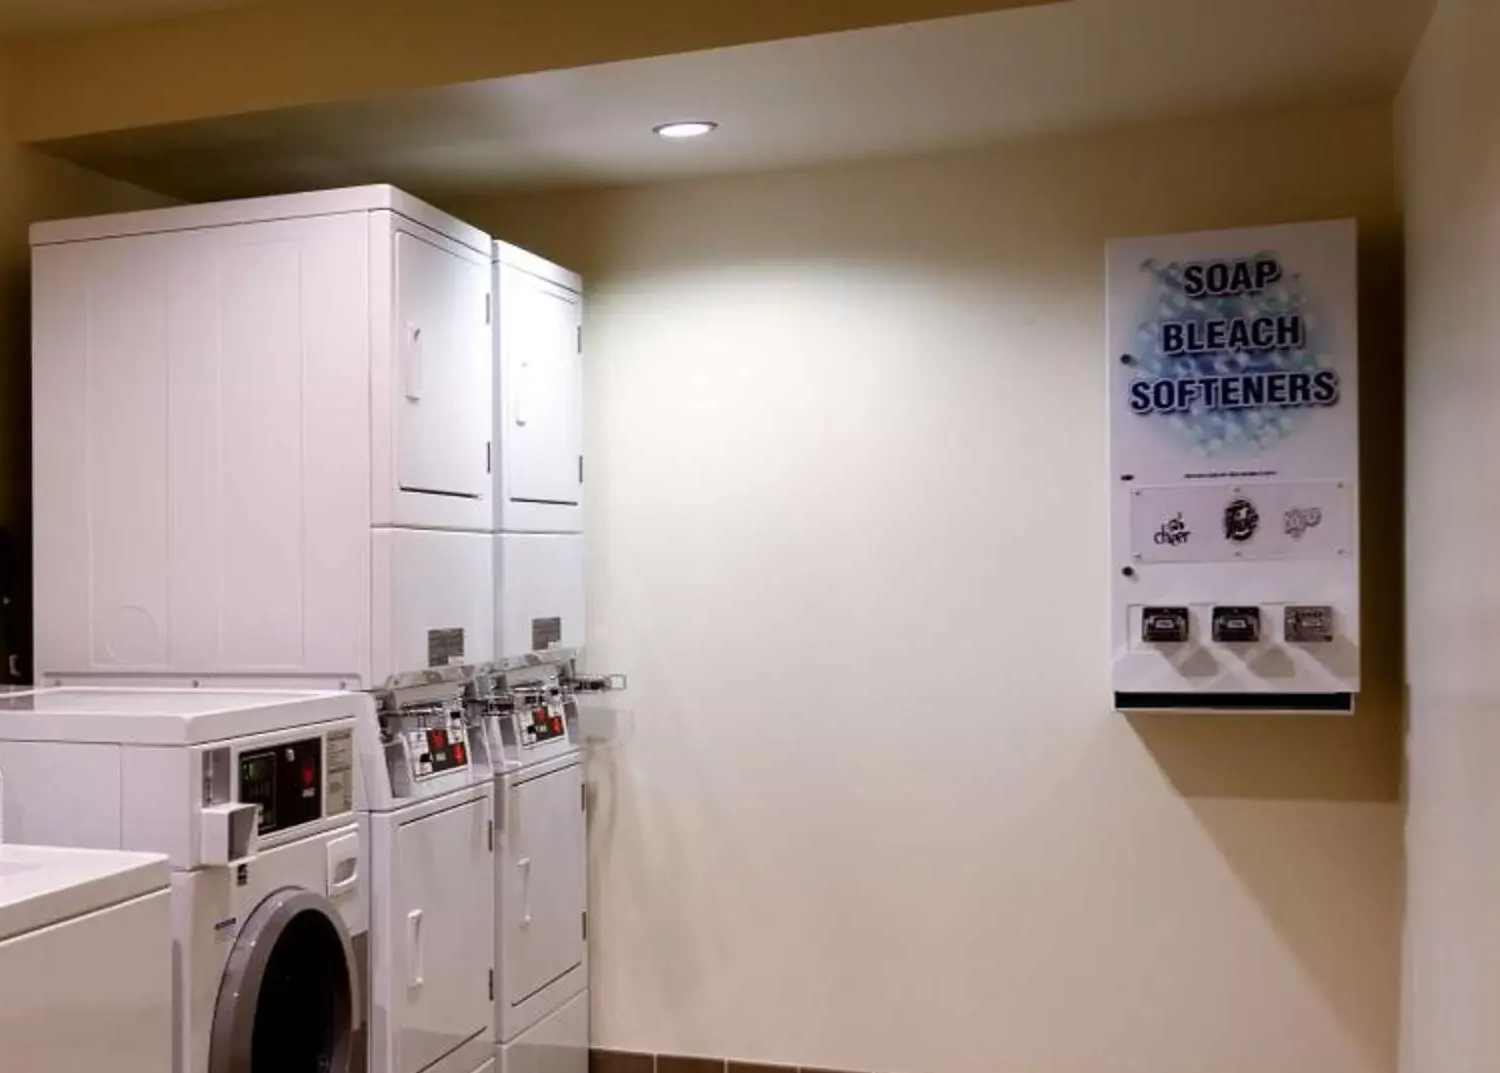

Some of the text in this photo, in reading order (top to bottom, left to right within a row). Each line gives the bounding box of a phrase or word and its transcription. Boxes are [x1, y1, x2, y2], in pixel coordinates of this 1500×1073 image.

[1183, 258, 1281, 298] SOAP
[1162, 315, 1305, 354] BLEACH
[1130, 370, 1339, 413] SOFTENERS
